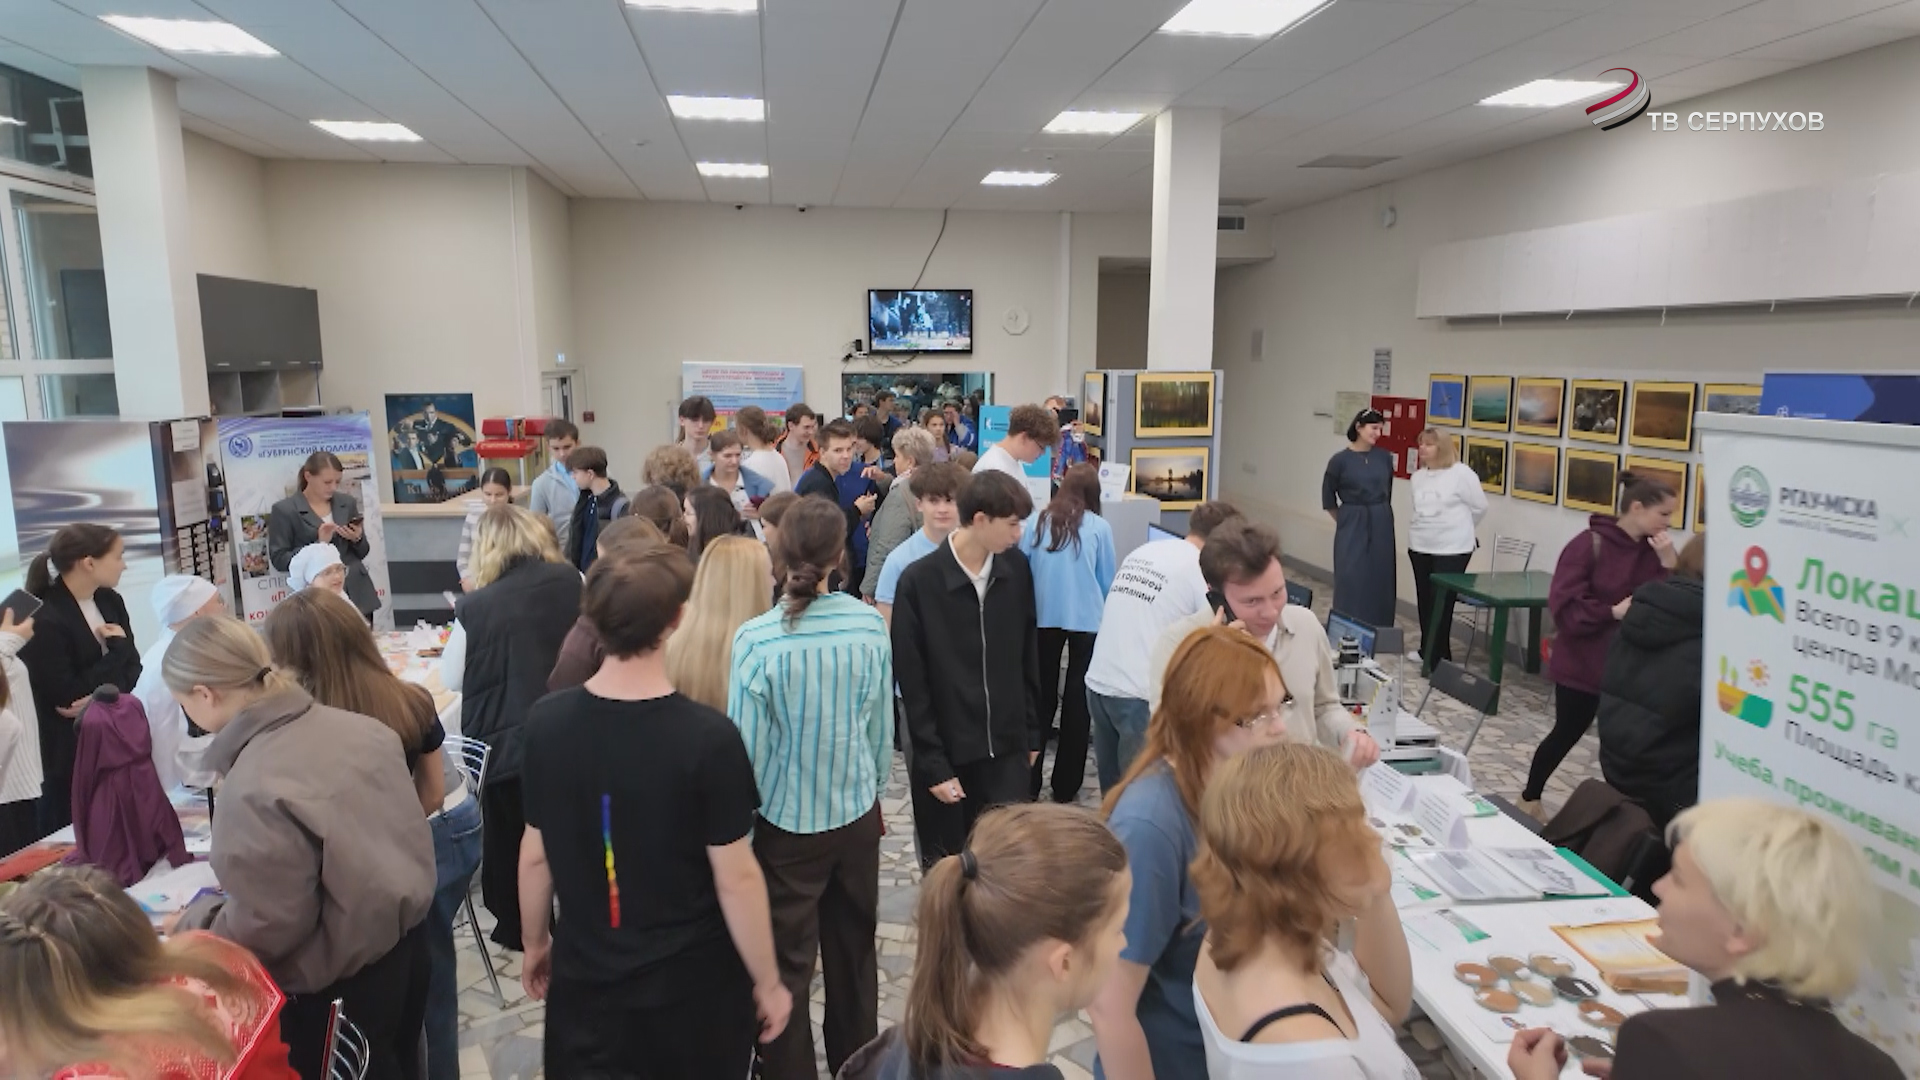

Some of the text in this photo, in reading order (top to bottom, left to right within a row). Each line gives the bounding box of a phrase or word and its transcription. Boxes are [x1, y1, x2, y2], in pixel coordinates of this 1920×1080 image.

[1796, 599, 1861, 636] Всего
[1865, 622, 1882, 642] в
[1886, 624, 1904, 648] 9
[1793, 635, 1879, 676] центра
[1787, 674, 1898, 749] 555 га
[1785, 718, 1898, 784] Площадь
